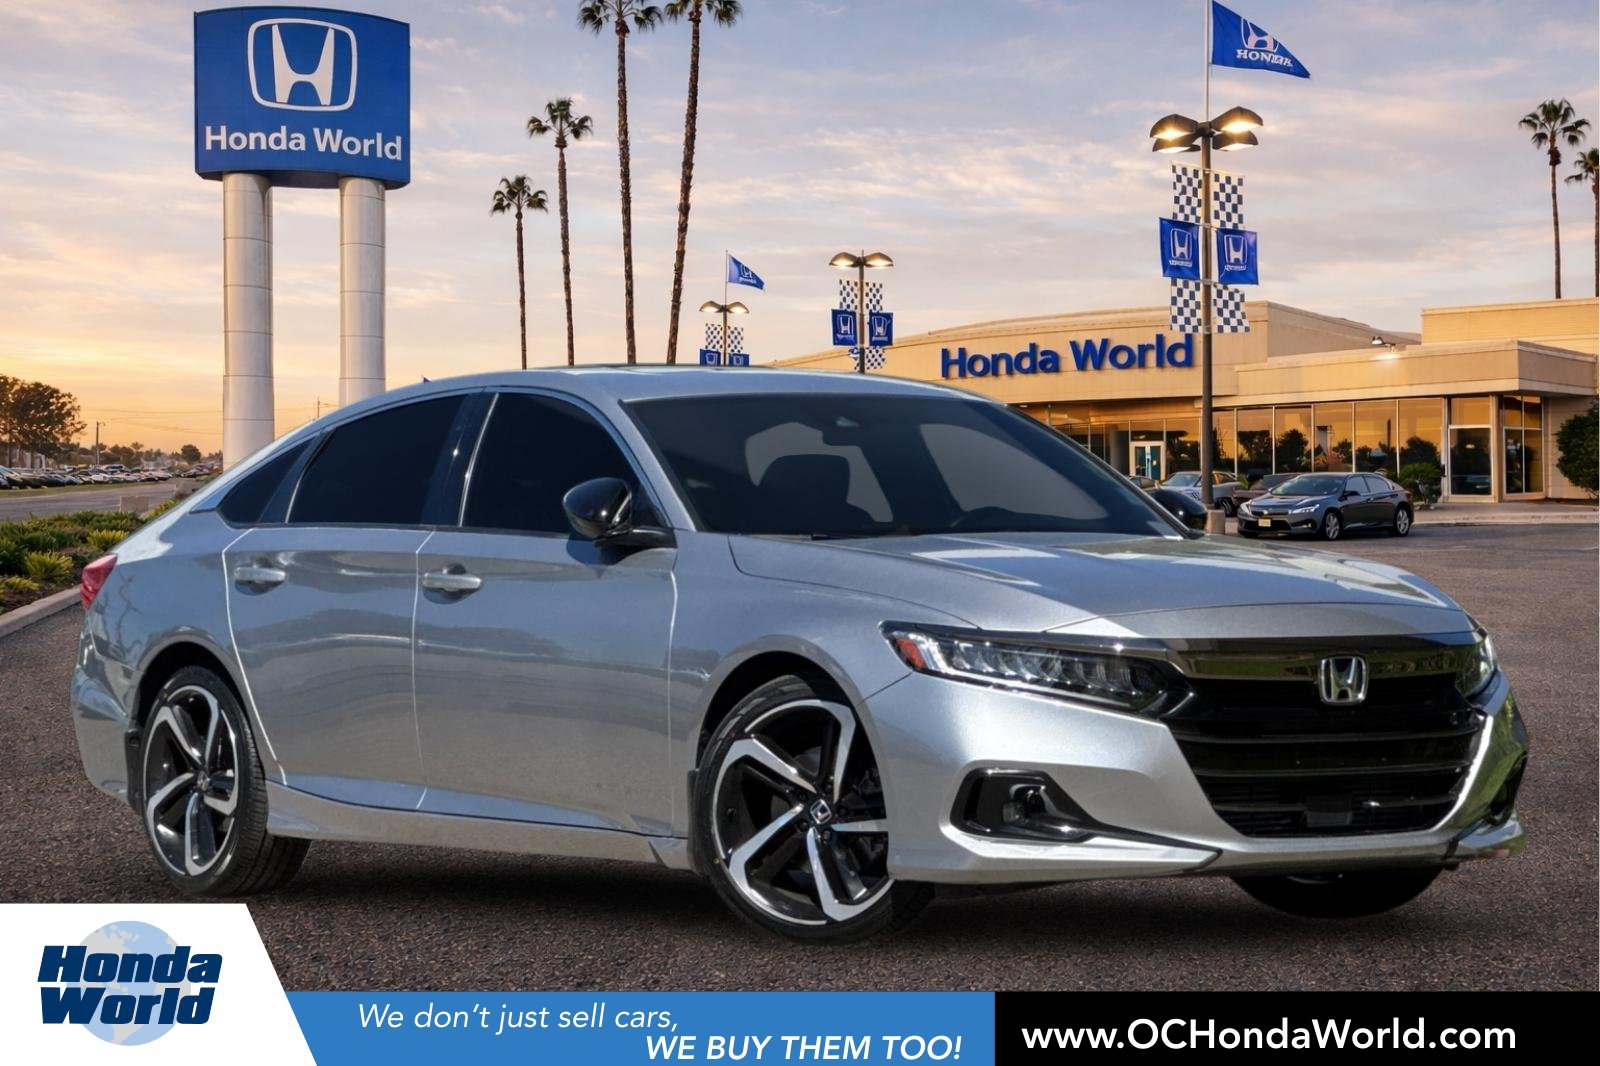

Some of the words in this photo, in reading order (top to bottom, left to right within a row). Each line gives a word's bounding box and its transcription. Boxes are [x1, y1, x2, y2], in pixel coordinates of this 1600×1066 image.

[205, 125, 306, 151] Honda
[313, 127, 402, 160] World
[940, 342, 1061, 378] Honda
[1069, 333, 1194, 371] World
